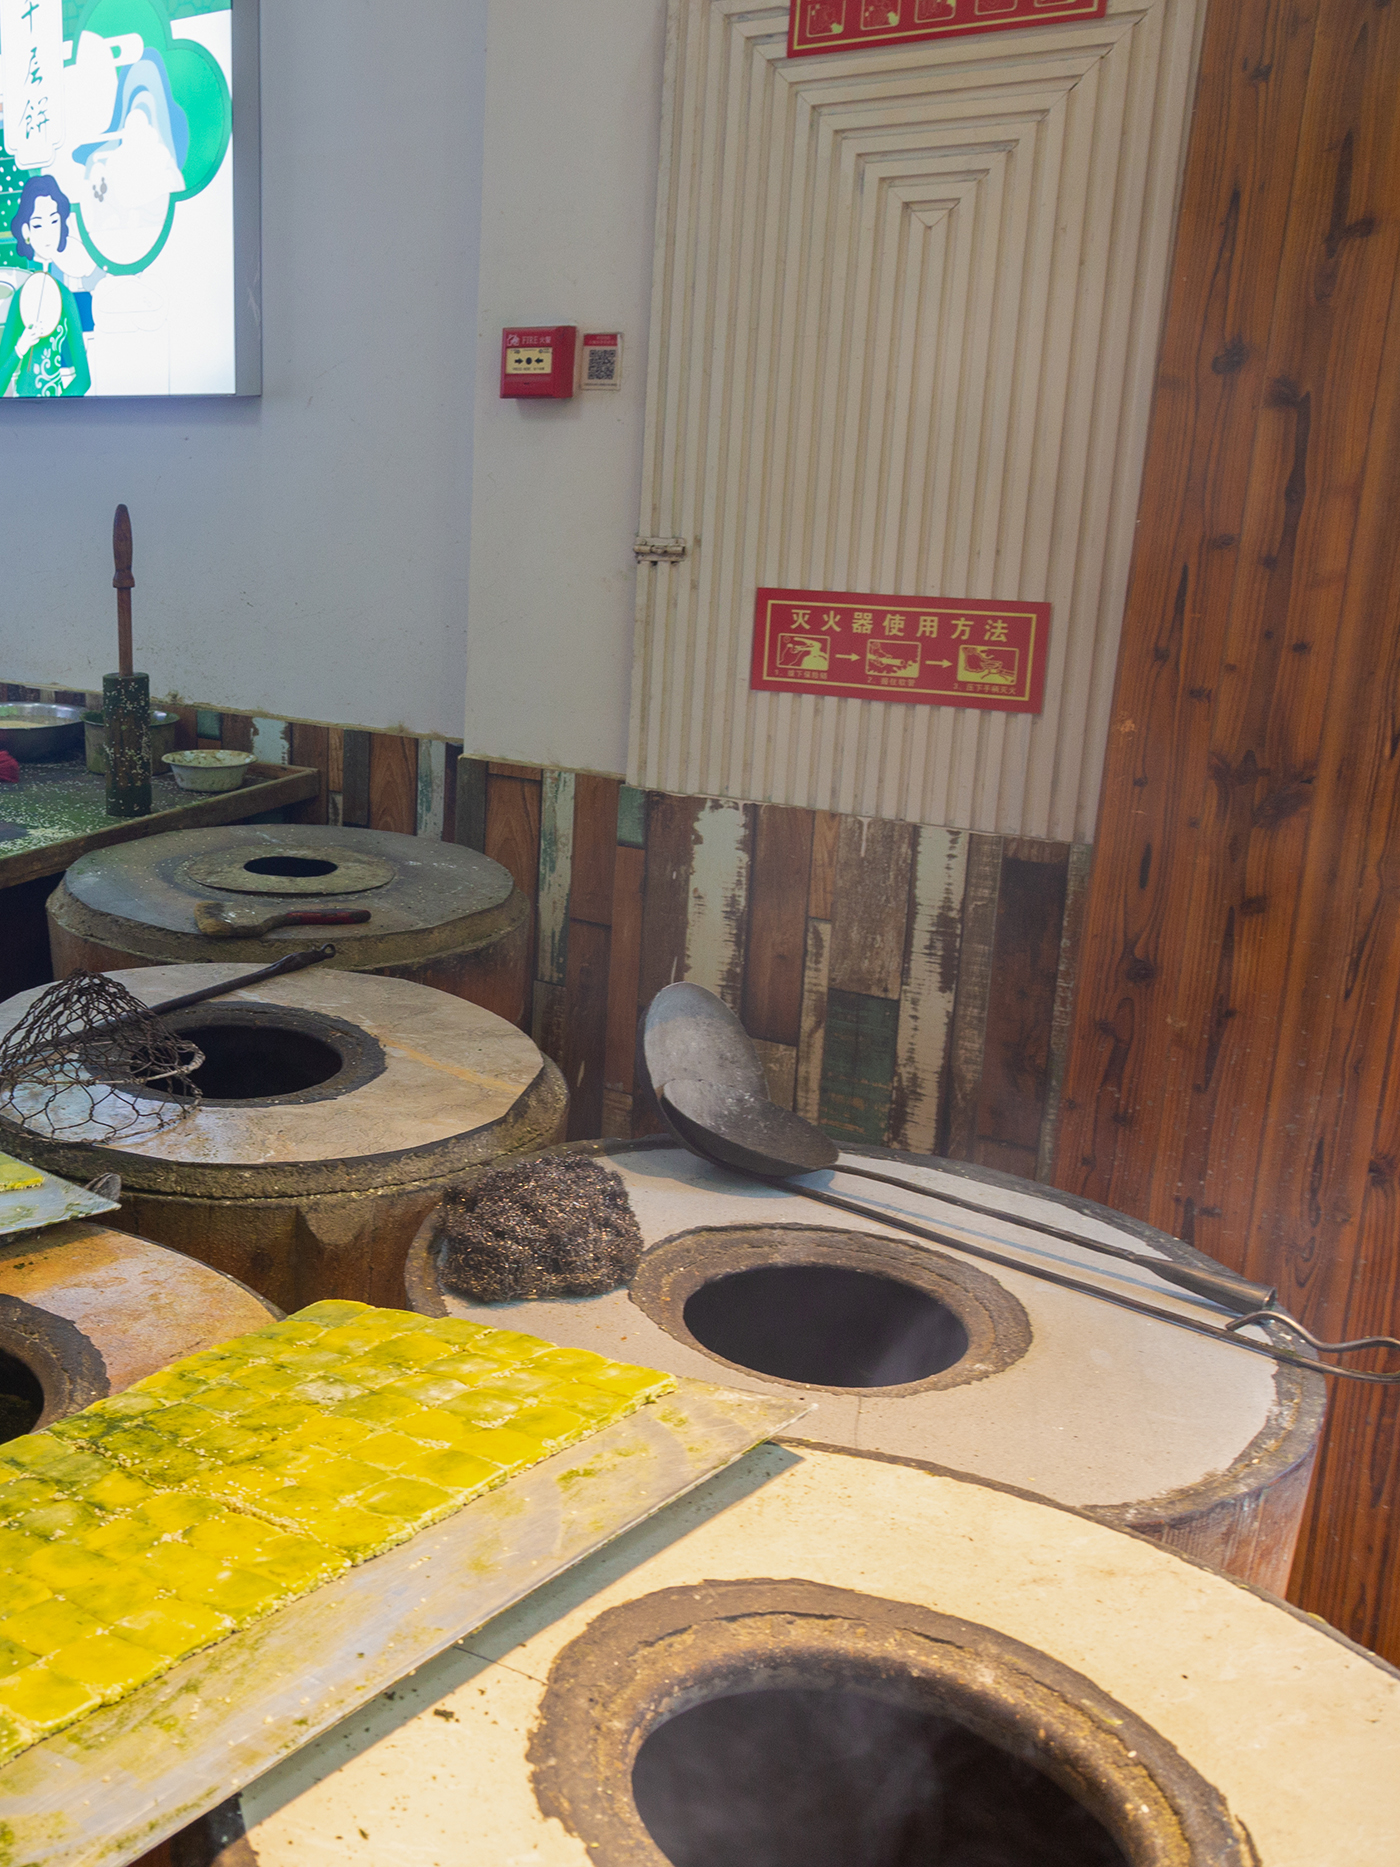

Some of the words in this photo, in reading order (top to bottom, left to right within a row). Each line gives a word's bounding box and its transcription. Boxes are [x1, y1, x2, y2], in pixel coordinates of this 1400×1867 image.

[522, 336, 538, 345] FIRE
[790, 609, 1009, 642] 灭火器使用方法
